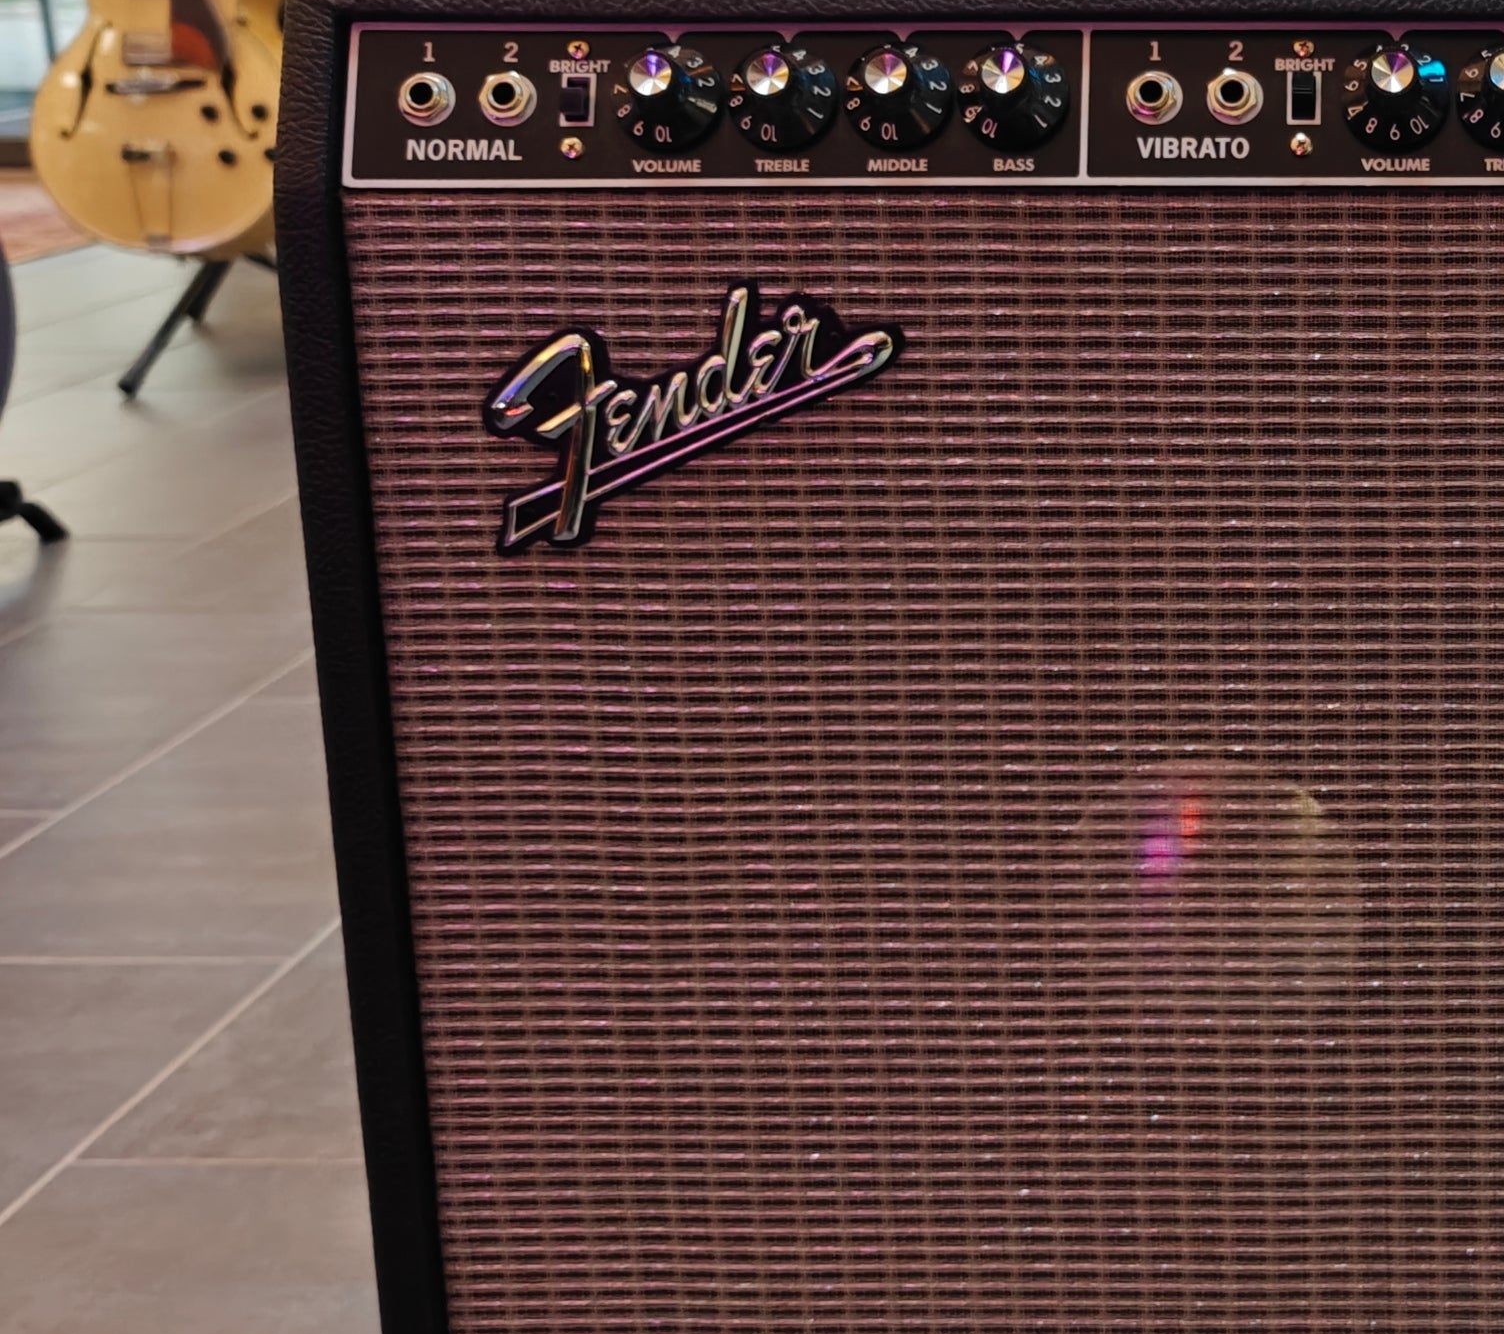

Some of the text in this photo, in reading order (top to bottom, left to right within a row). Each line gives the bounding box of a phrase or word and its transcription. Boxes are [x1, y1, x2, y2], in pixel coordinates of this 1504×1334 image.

[423, 42, 436, 63] 1
[503, 42, 519, 63] 2
[792, 49, 807, 61] 4
[905, 47, 919, 58] 4
[1149, 41, 1161, 61] 1
[1228, 41, 1244, 61] 2
[550, 59, 611, 73] BRIGHT
[687, 57, 704, 69] 3
[921, 59, 939, 71] 3
[1034, 55, 1048, 66] 4
[1275, 58, 1336, 72] BRIGHT
[1353, 59, 1367, 71] 5
[807, 65, 825, 75] 3
[1465, 68, 1479, 78] 6
[698, 77, 715, 87] 2
[1044, 73, 1061, 83] 3
[613, 84, 629, 94] 7
[813, 86, 831, 97] 2
[929, 81, 947, 91] 2
[960, 83, 975, 94] 8
[1344, 80, 1359, 92] 6
[729, 95, 744, 108] 8
[846, 97, 860, 110] 8
[1044, 95, 1061, 108] 2
[1460, 92, 1475, 102] 7
[617, 104, 631, 118] 8
[807, 107, 824, 119] 1
[925, 102, 942, 114] 1
[741, 116, 752, 130] 9
[860, 116, 872, 131] 9
[1034, 114, 1048, 128] 1
[1469, 109, 1484, 124] 8
[633, 121, 645, 136] 9
[881, 122, 898, 141] 10
[981, 118, 998, 139] 10
[1365, 117, 1378, 134] 8
[1389, 123, 1401, 141] 9
[1409, 115, 1429, 135] 10
[1490, 122, 1501, 138] 9
[655, 125, 672, 143] 10
[761, 123, 778, 142] 10
[406, 139, 523, 161] NORMAL
[1136, 137, 1250, 159] VIBRATO
[632, 159, 702, 173] VOLUME
[755, 159, 810, 172] TREBLE
[867, 158, 928, 172] MIDDLE
[992, 158, 1035, 172] BASS
[1360, 158, 1431, 172] VOLUME
[492, 287, 894, 547] Fender
